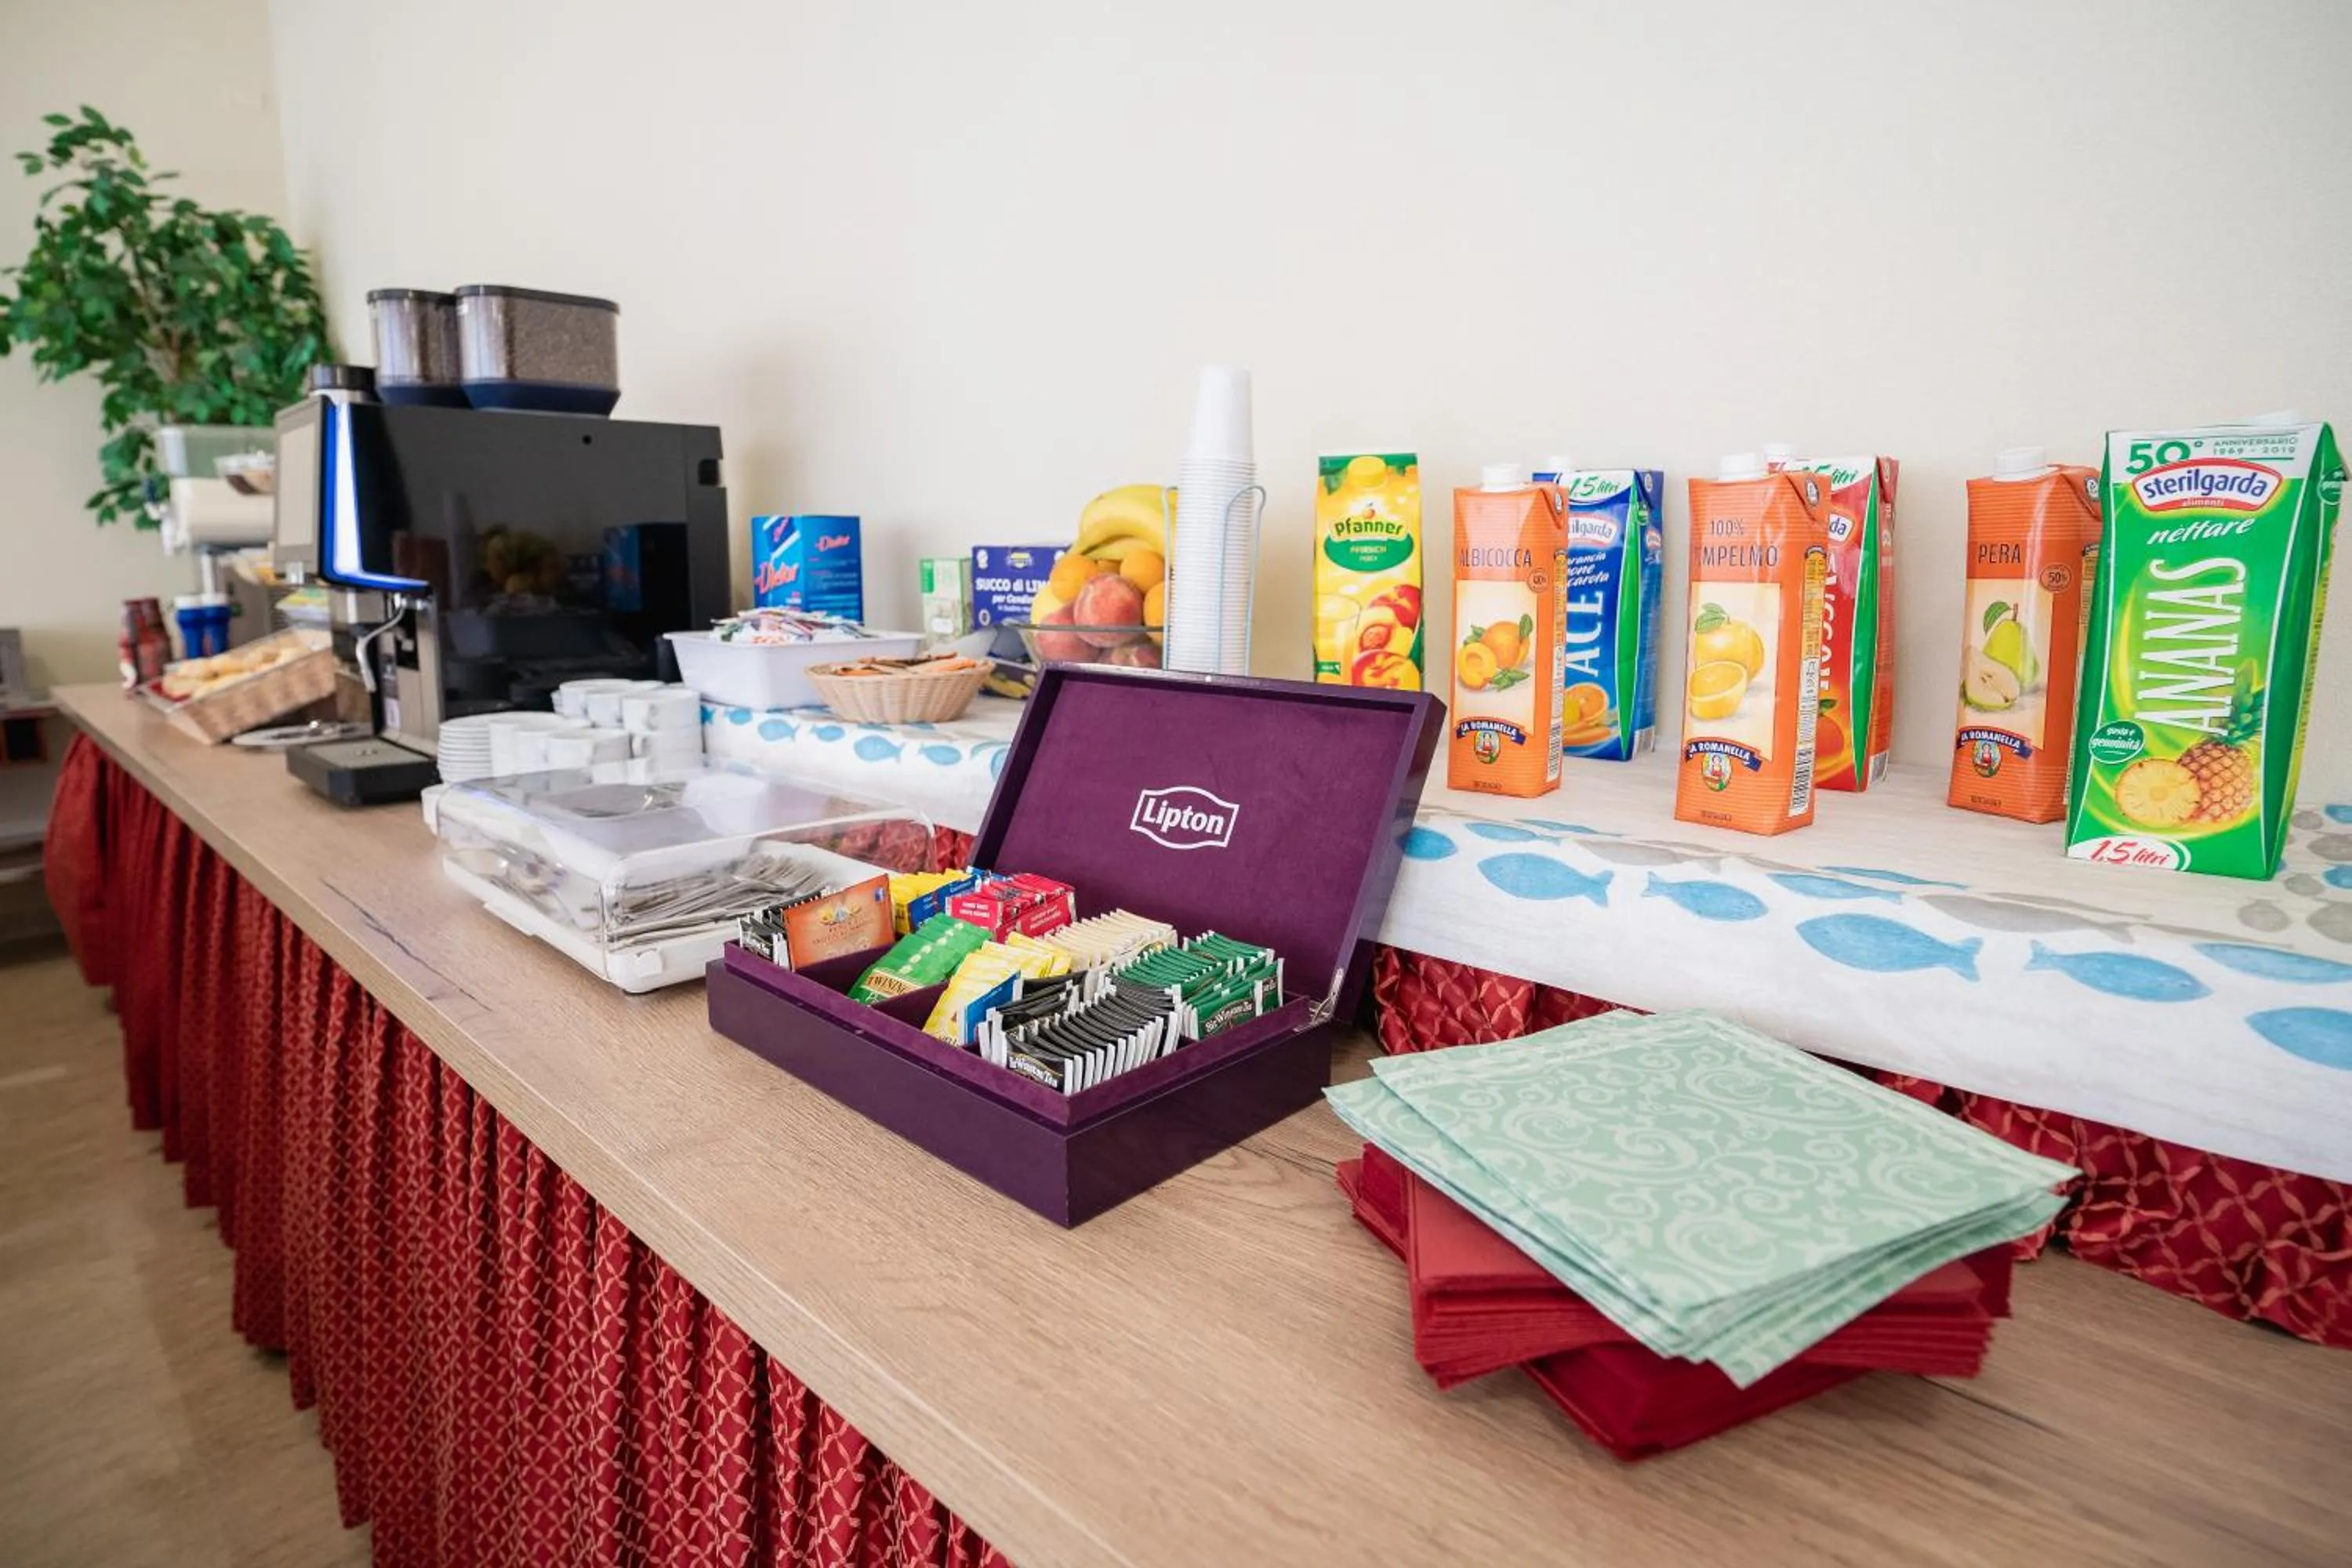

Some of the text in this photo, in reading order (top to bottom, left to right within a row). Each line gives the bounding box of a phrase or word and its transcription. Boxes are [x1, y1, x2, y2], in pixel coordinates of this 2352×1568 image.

[2213, 446, 2244, 455] 1969
[2263, 446, 2296, 455] 2019
[2214, 437, 2298, 447] ANNIVERSARIO
[2143, 468, 2267, 499] sterilgarda
[2182, 498, 2225, 507] alimenti
[1334, 517, 1404, 537] pfanner
[1569, 518, 1613, 539] ilgarda
[1711, 518, 1744, 536] 100%
[2147, 517, 2256, 546] nettare
[1459, 547, 1532, 567] ALBICOCCA
[1699, 544, 1778, 567] MPELMO
[1978, 543, 2021, 564] PERA
[975, 577, 1011, 592] SUCCO
[1012, 578, 1024, 593] di
[2134, 557, 2247, 737] ANANAS
[1471, 721, 1517, 736] ROMANELLA
[1969, 730, 2020, 749] ROMANELLA
[1698, 742, 1751, 760] ROMANELLA
[1142, 797, 1225, 835] Lipton
[2132, 848, 2171, 866] litri
